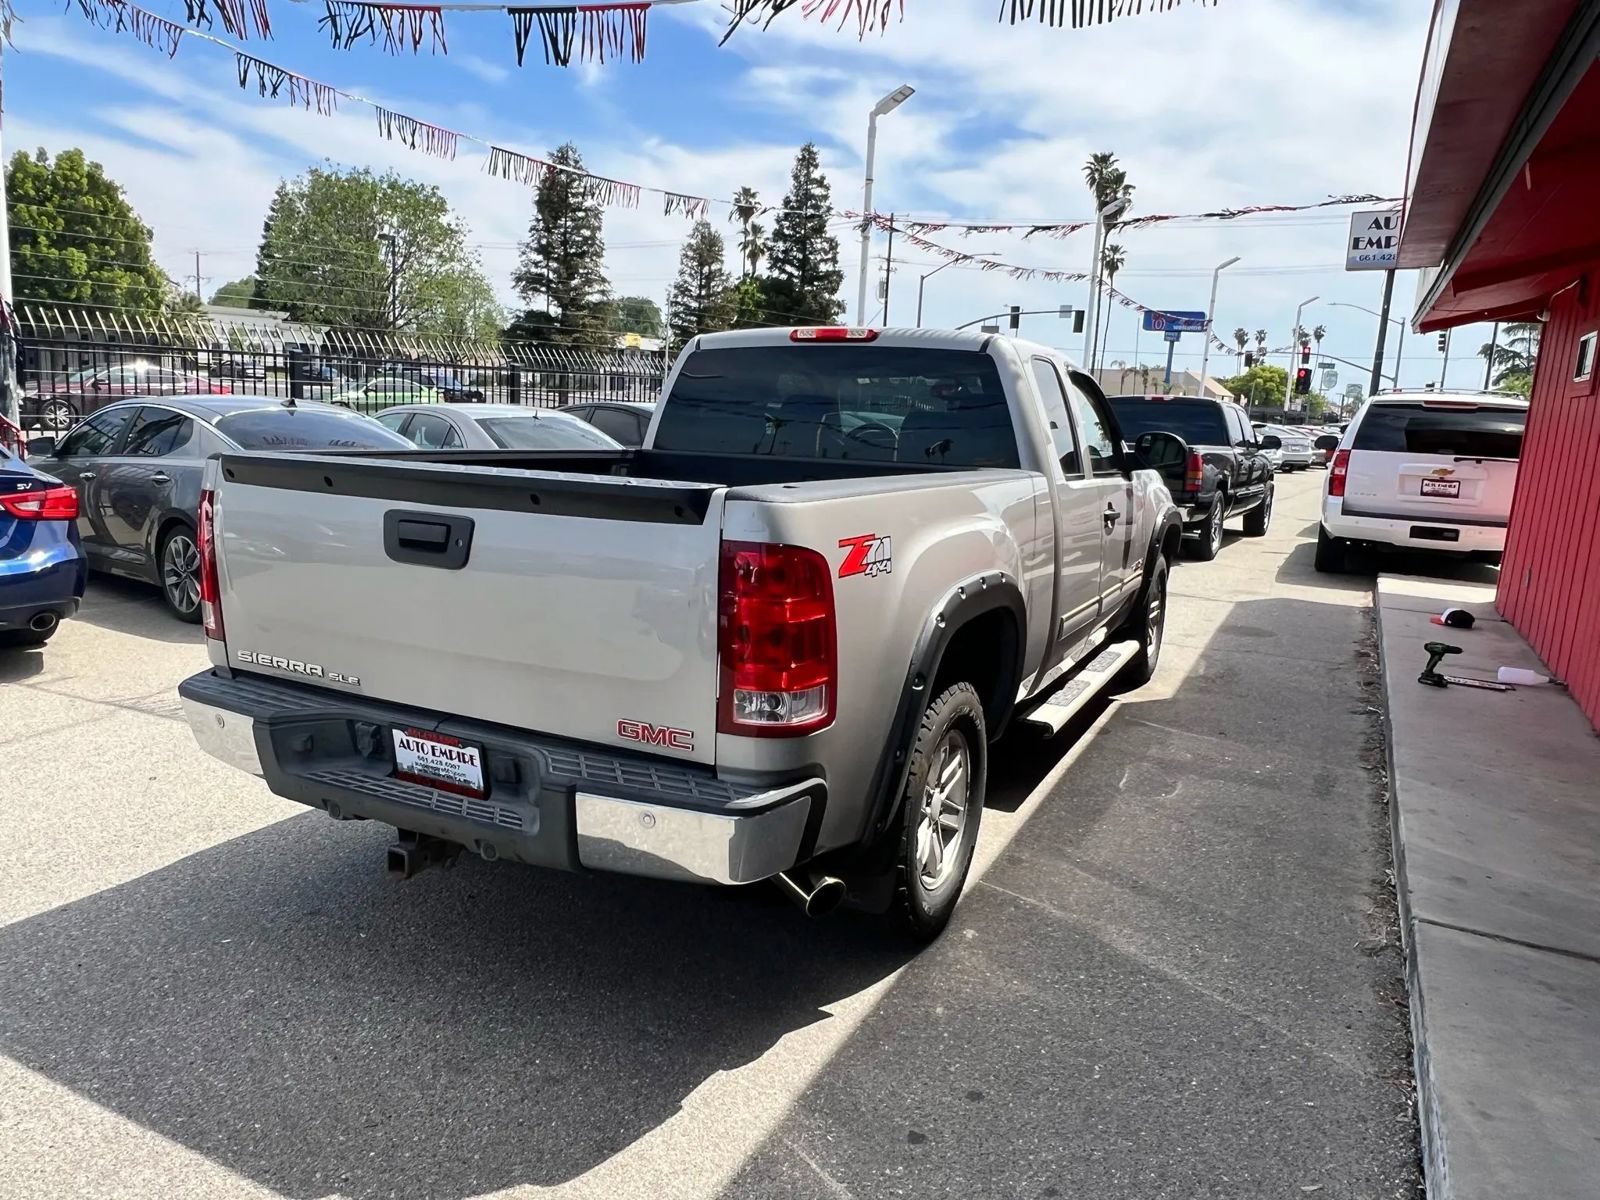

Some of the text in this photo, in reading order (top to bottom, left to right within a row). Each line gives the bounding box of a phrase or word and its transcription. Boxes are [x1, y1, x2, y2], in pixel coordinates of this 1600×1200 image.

[16, 483, 33, 491] SV
[838, 533, 892, 579] Z71
[237, 649, 361, 686] SIERRA SLE
[616, 718, 695, 752] GMC
[399, 738, 478, 768] AUTO EMPIRE
